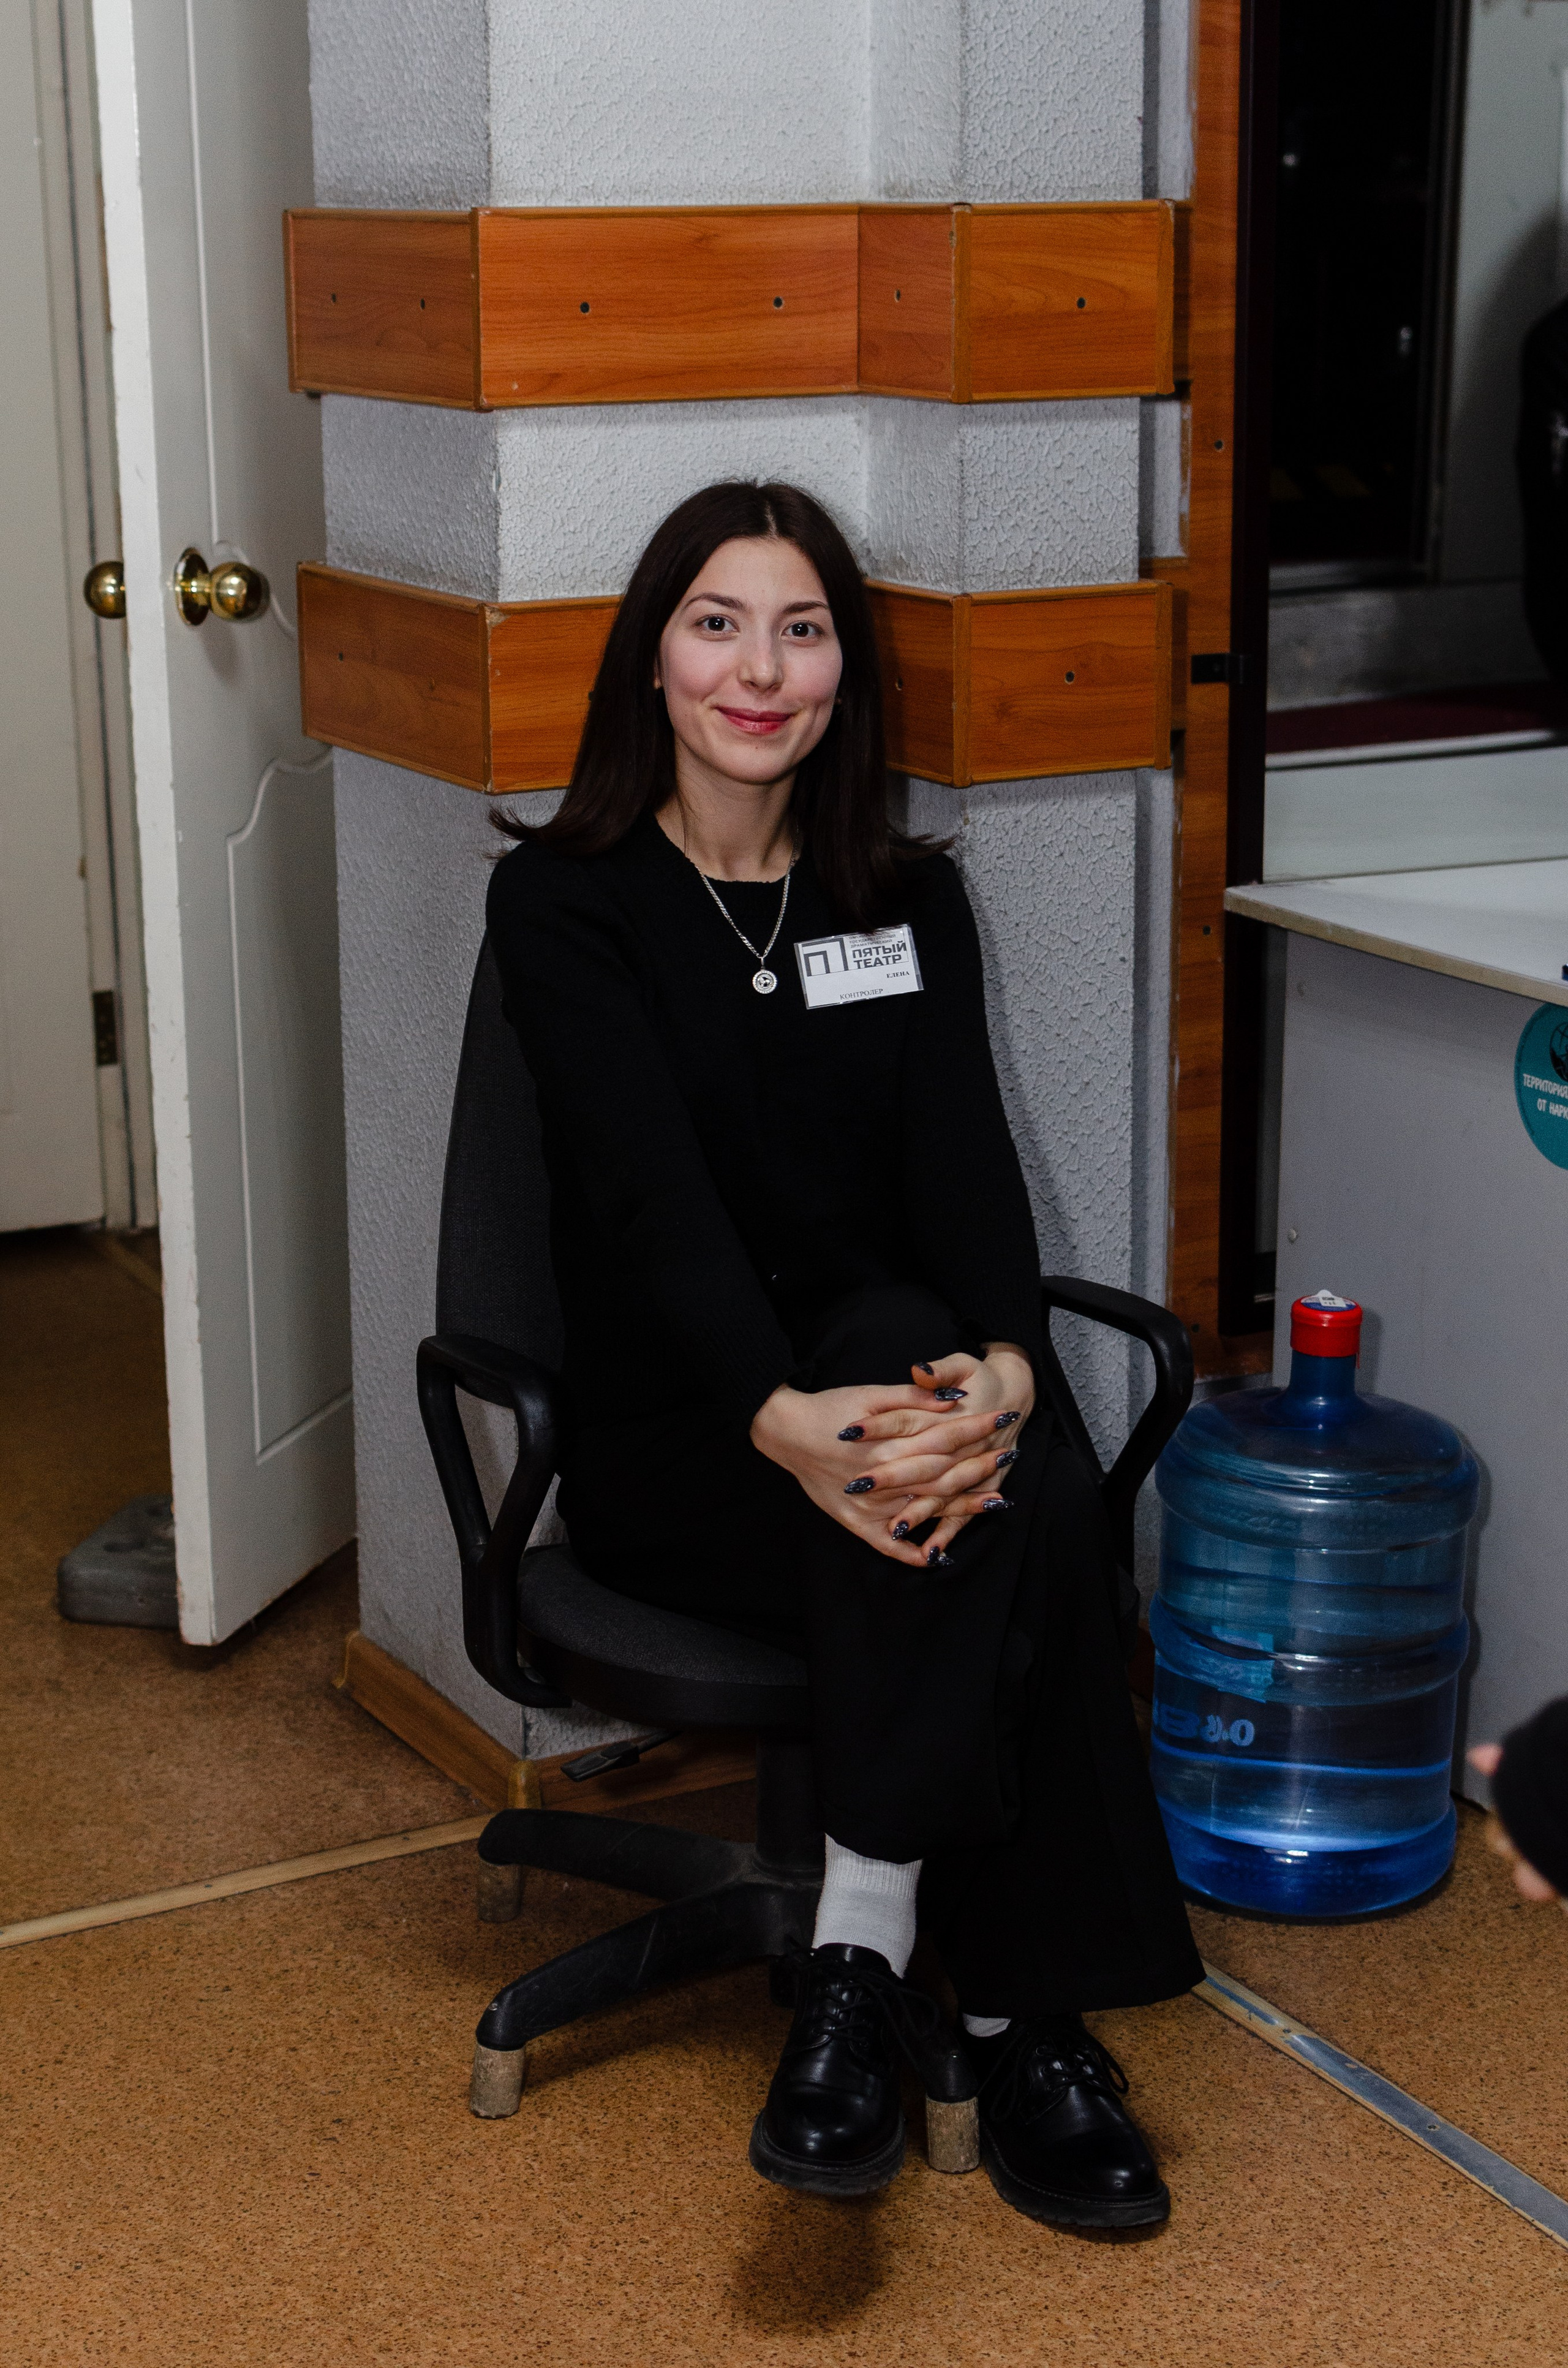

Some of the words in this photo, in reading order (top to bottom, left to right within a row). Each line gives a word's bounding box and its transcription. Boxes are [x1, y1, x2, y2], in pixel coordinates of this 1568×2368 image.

[852, 940, 907, 959] ПЯТЫЙ
[853, 954, 902, 969] ТЕАТР
[840, 988, 883, 1000] КОНТРОЛЕР
[1537, 1098, 1547, 1112] ОТ
